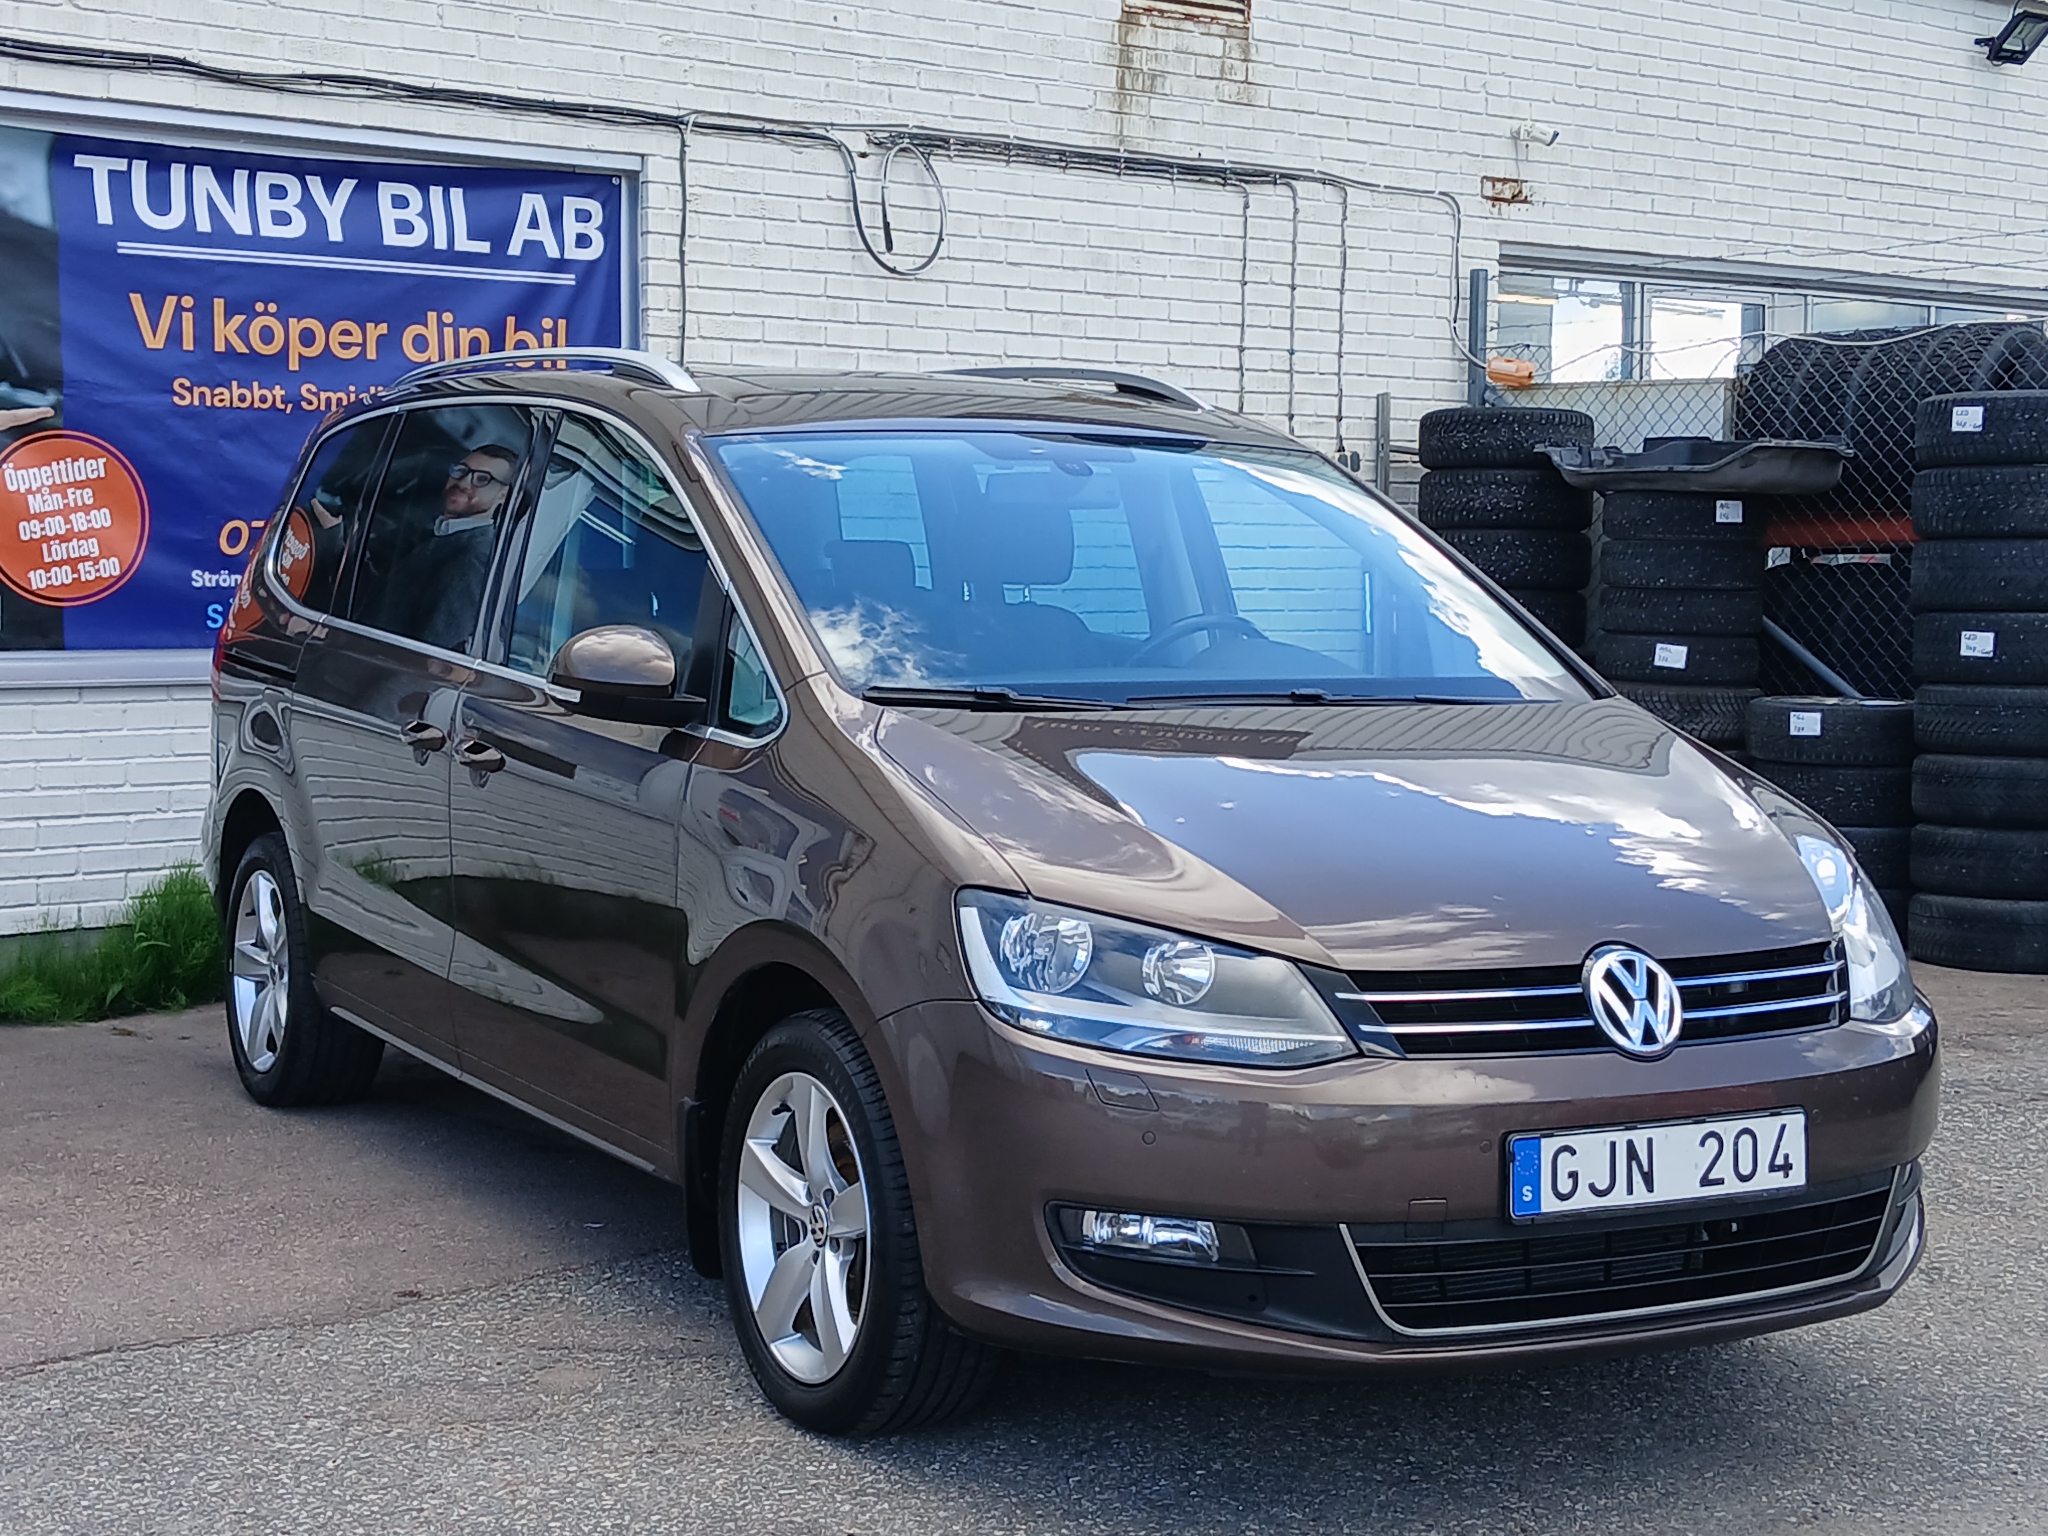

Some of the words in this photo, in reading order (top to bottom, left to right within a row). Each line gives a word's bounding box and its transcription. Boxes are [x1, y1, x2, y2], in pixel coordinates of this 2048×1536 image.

[73, 154, 358, 242] TUNBY
[377, 181, 491, 254] BIL
[506, 192, 605, 261] AB
[129, 292, 194, 351] Vi
[213, 297, 388, 371] köper
[402, 311, 490, 363] din
[504, 315, 567, 369] bil
[172, 377, 294, 414] Snabbt,
[2, 457, 107, 493] Öppettider
[27, 486, 94, 514] Mån-Fre
[18, 507, 112, 541] 09:00-18:00
[42, 537, 100, 563] Lördag
[28, 556, 120, 590] 10:00-15:00
[1550, 1136, 1655, 1202] GJN
[1699, 1123, 1794, 1188] 204
[1522, 1185, 1533, 1201] S
